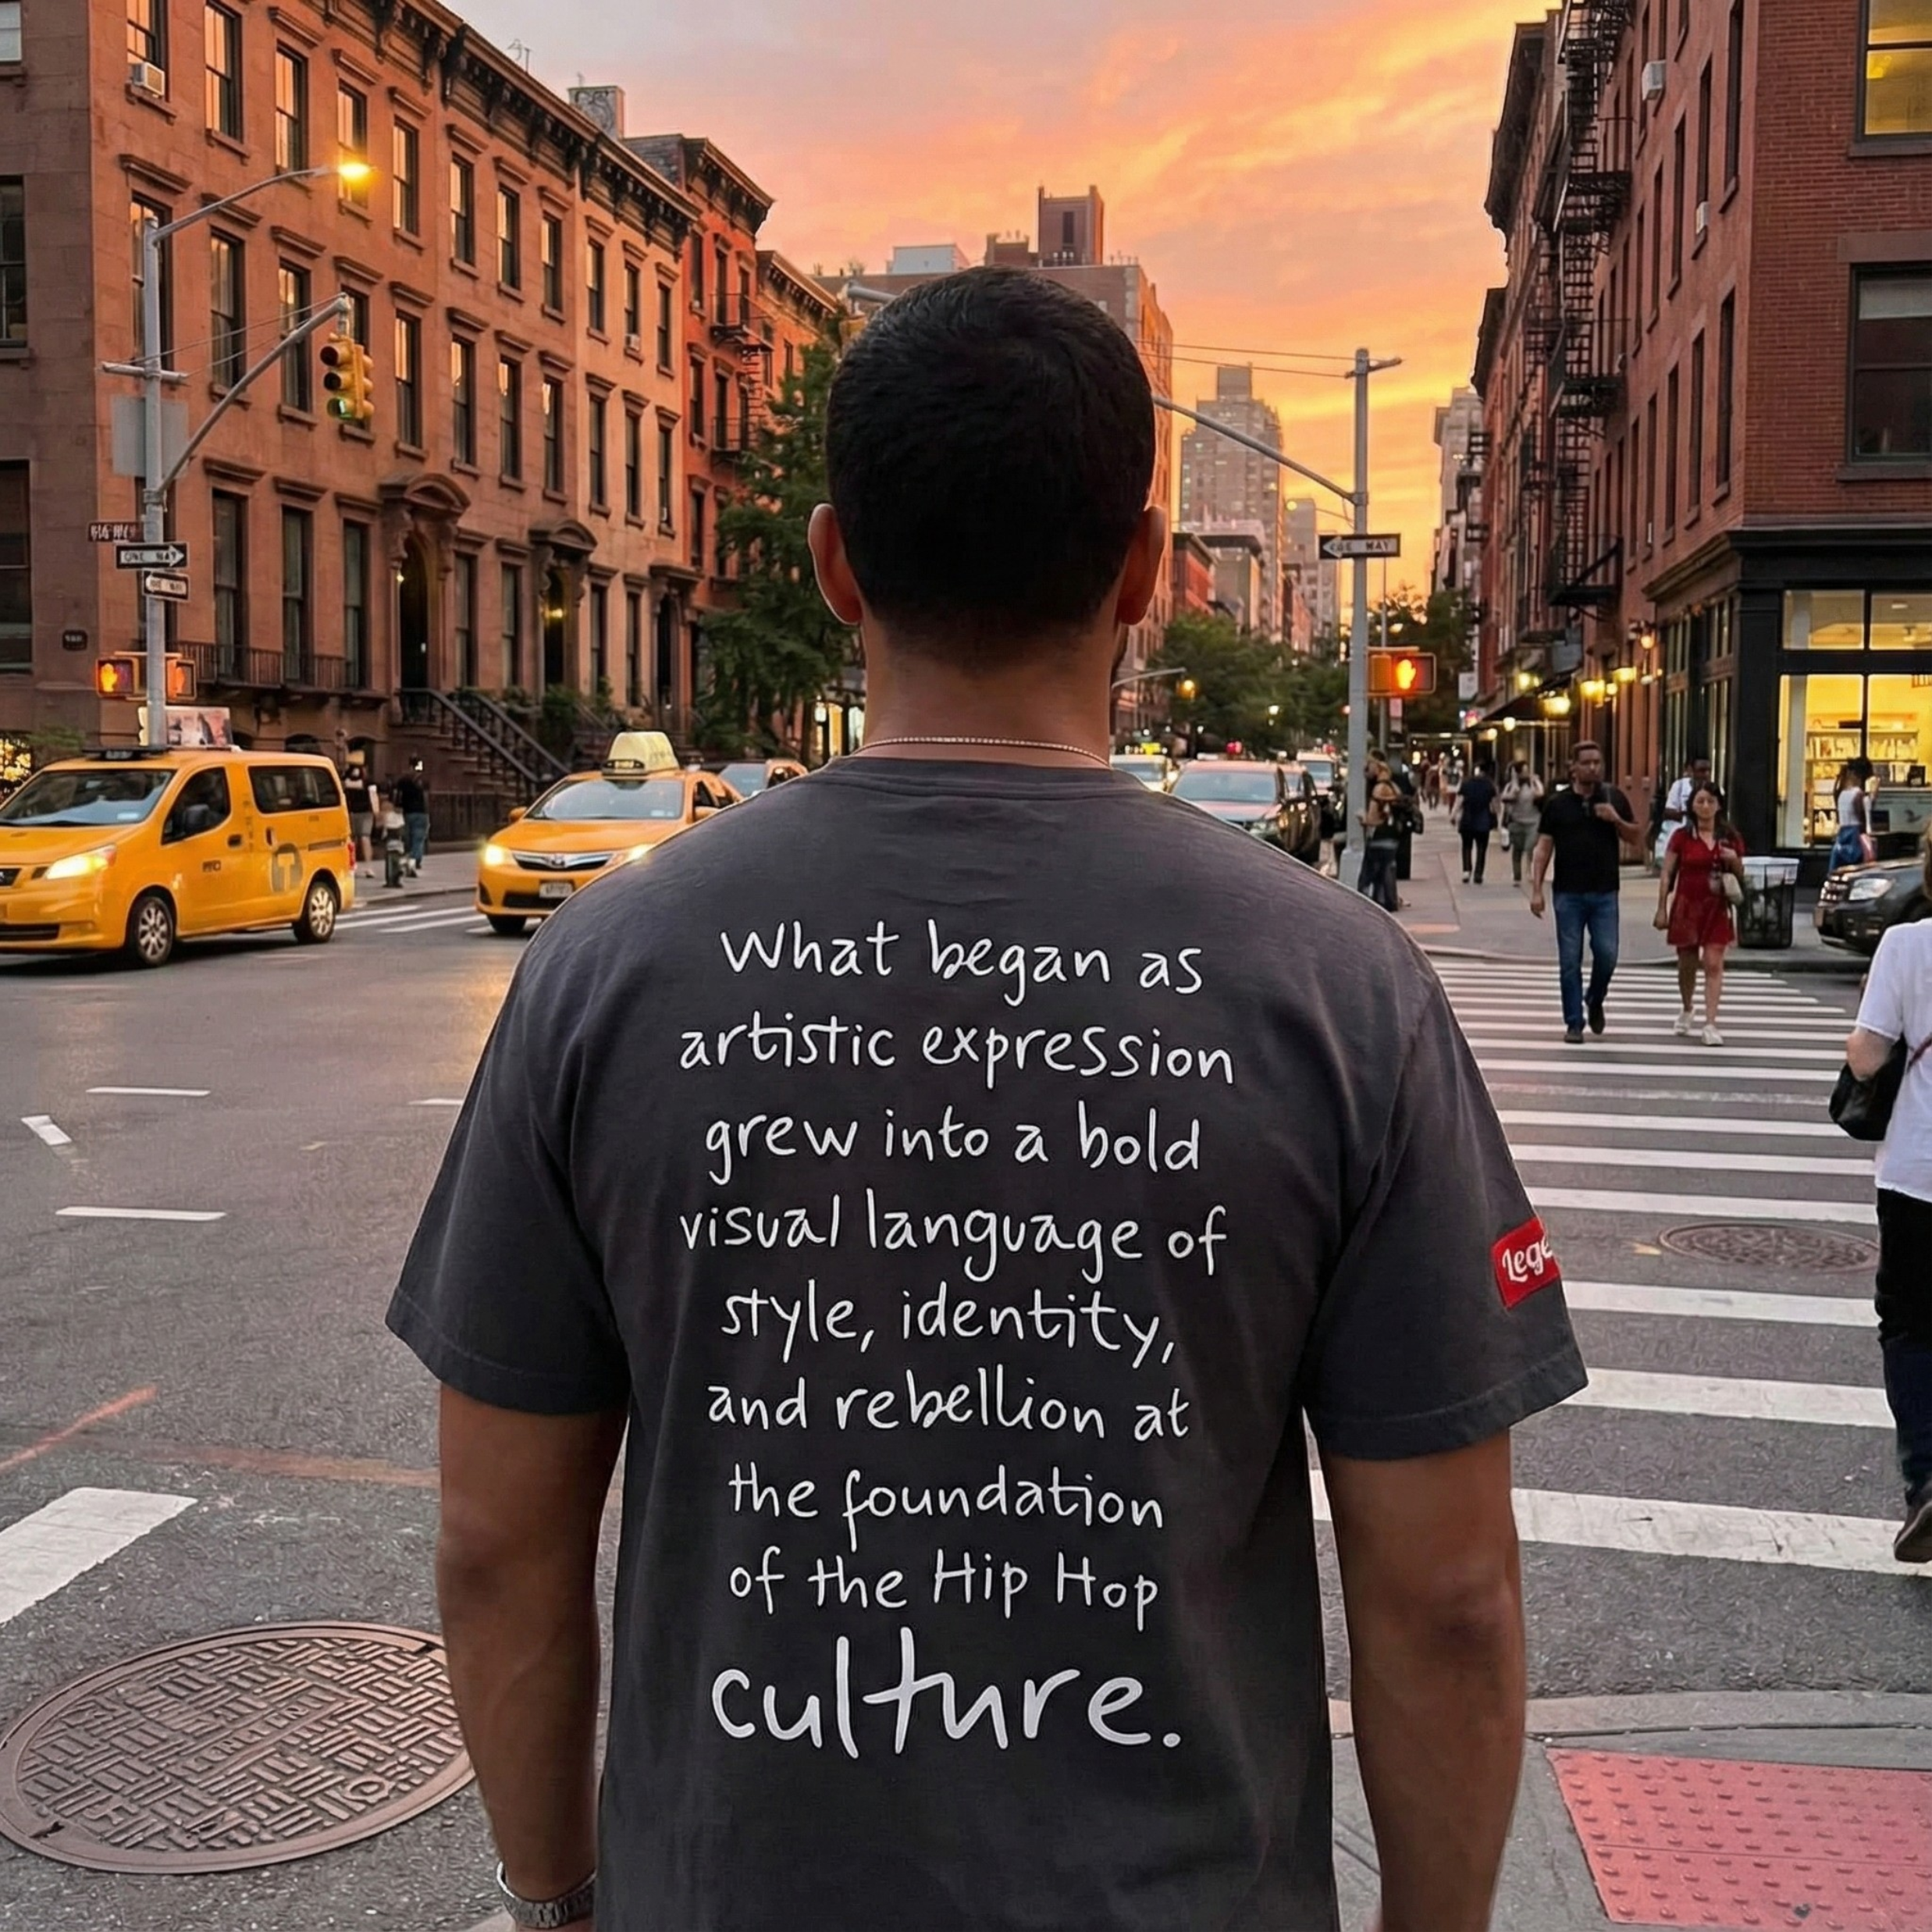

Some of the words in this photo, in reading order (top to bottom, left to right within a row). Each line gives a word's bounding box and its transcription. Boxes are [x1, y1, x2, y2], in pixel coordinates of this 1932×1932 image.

[1365, 540, 1389, 551] WAY
[720, 920, 899, 977] What
[927, 919, 1110, 1006] began
[1140, 948, 1202, 994] as
[680, 1011, 895, 1069] artistic
[923, 1026, 1233, 1089] expression
[706, 1115, 858, 1185] grew
[885, 1105, 989, 1161] into
[1015, 1125, 1048, 1162] a
[1078, 1100, 1200, 1172] bold
[680, 1194, 840, 1250] visual
[866, 1188, 1143, 1284] language
[1168, 1205, 1226, 1276] of
[721, 1279, 874, 1363] style,
[903, 1281, 1174, 1368] identity,
[708, 1377, 807, 1430] and
[836, 1364, 1105, 1438] rebellion
[1134, 1388, 1189, 1441] at
[728, 1461, 818, 1517] the
[842, 1464, 1162, 1552] foundation
[730, 1546, 785, 1614] of
[808, 1555, 907, 1608] the
[934, 1549, 1027, 1618] Hip
[1057, 1552, 1158, 1631] Hop
[712, 1627, 1180, 1759] culture.
